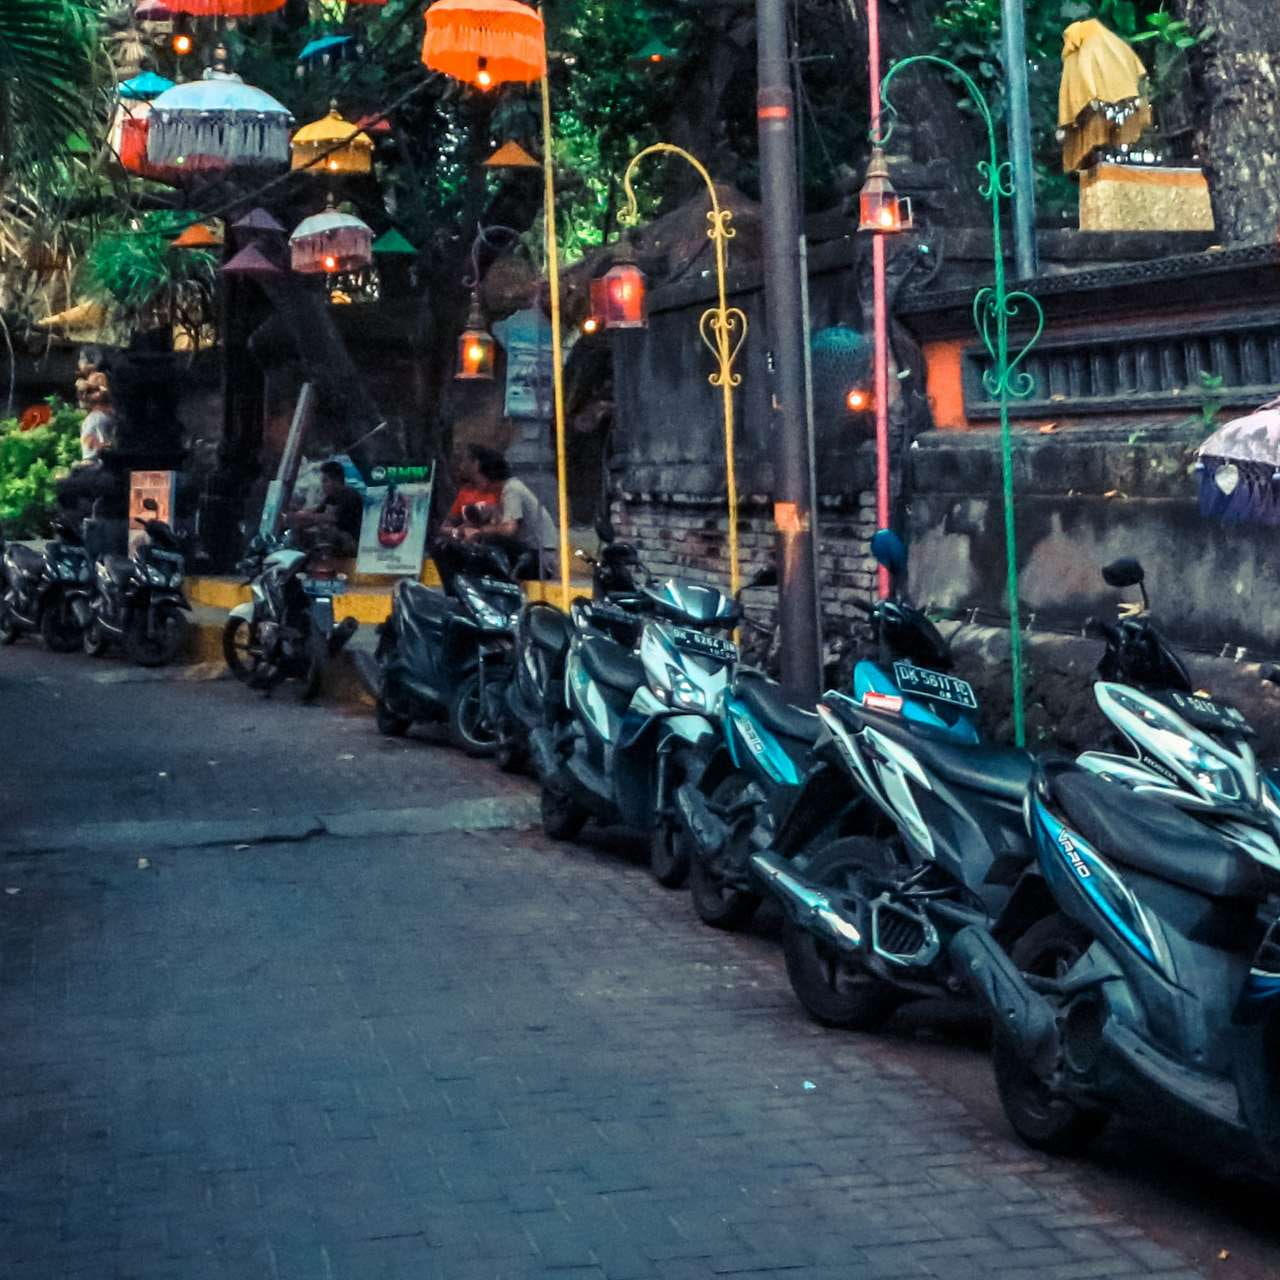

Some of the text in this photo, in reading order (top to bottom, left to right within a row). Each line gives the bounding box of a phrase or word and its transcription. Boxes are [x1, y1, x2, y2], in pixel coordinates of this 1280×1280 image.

[899, 666, 919, 683] DK
[1143, 755, 1179, 783] HONDA
[1058, 829, 1091, 878] VARIO
